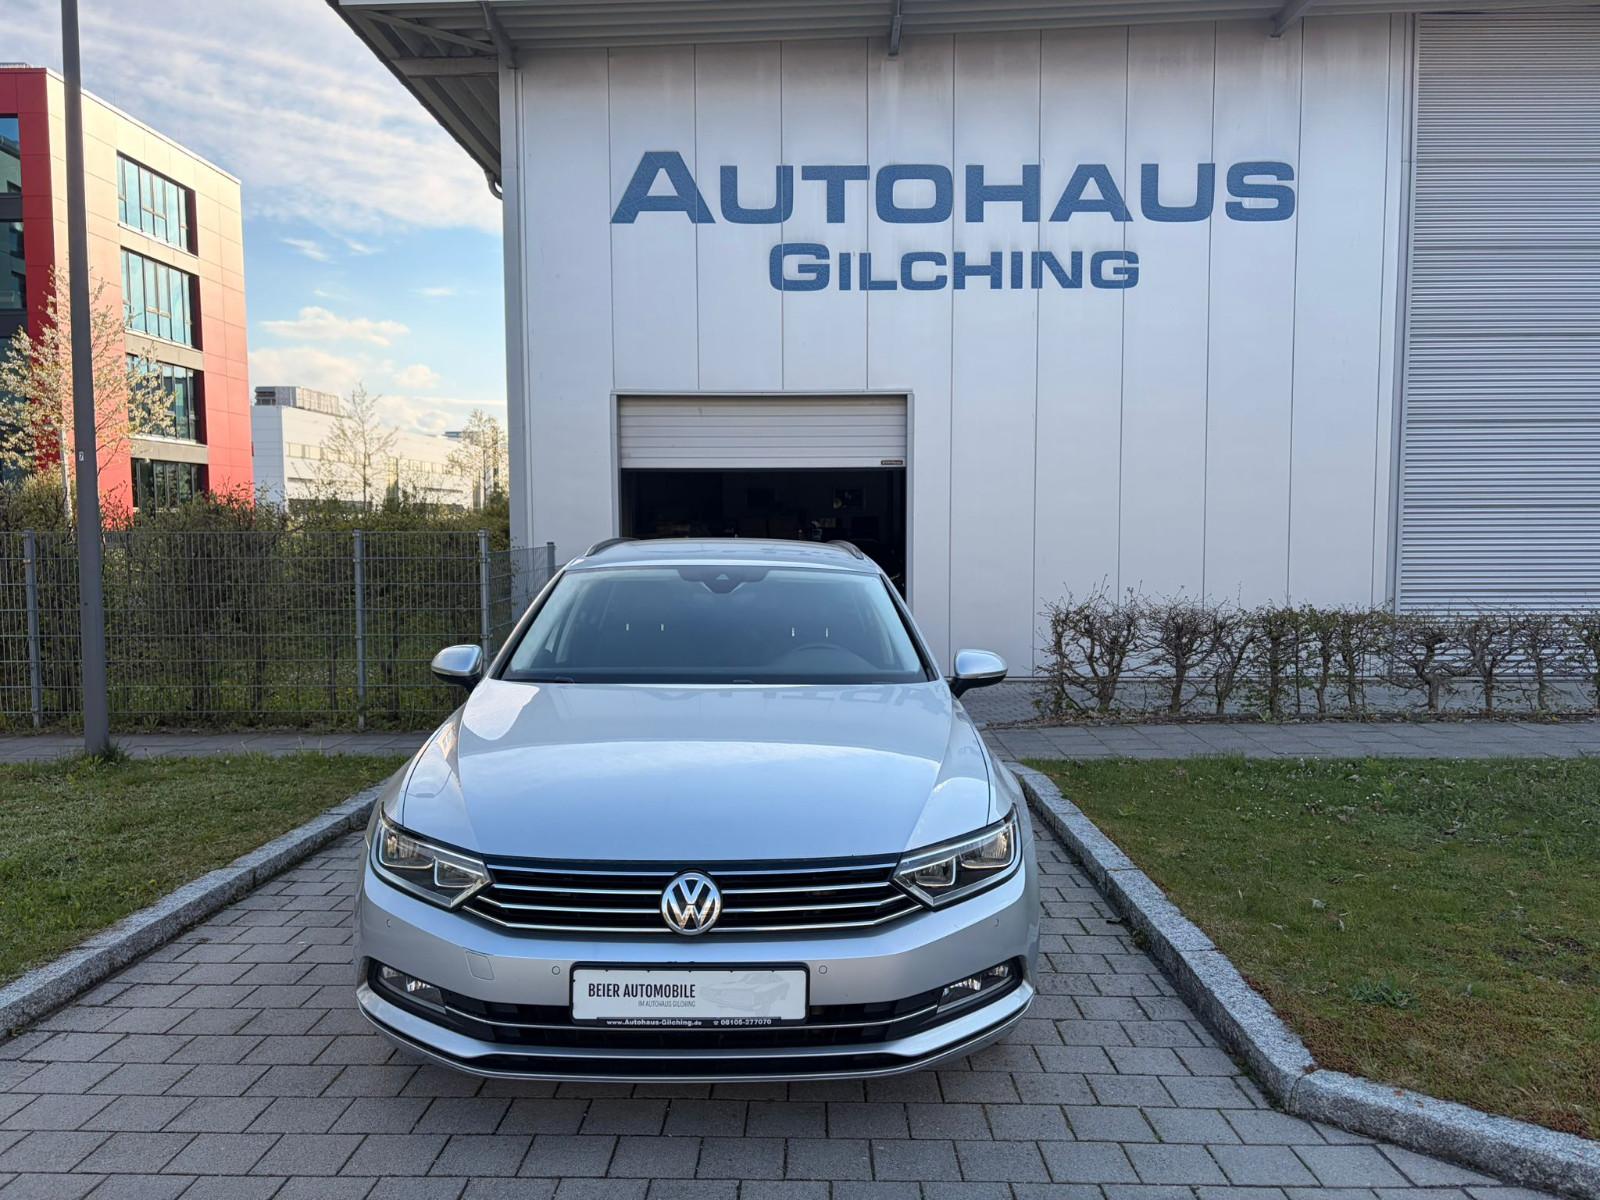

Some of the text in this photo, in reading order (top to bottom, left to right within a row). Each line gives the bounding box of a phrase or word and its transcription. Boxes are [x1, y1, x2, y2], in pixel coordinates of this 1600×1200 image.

[610, 151, 1295, 225] AUTOHAUS
[769, 243, 1139, 292] GILCHING
[663, 874, 720, 934] VW
[588, 983, 696, 999] BEIER AUTOMOBILE
[645, 1000, 672, 1008] AUTOHAUS
[606, 1018, 702, 1027] www.Autohaus-Gilching.de
